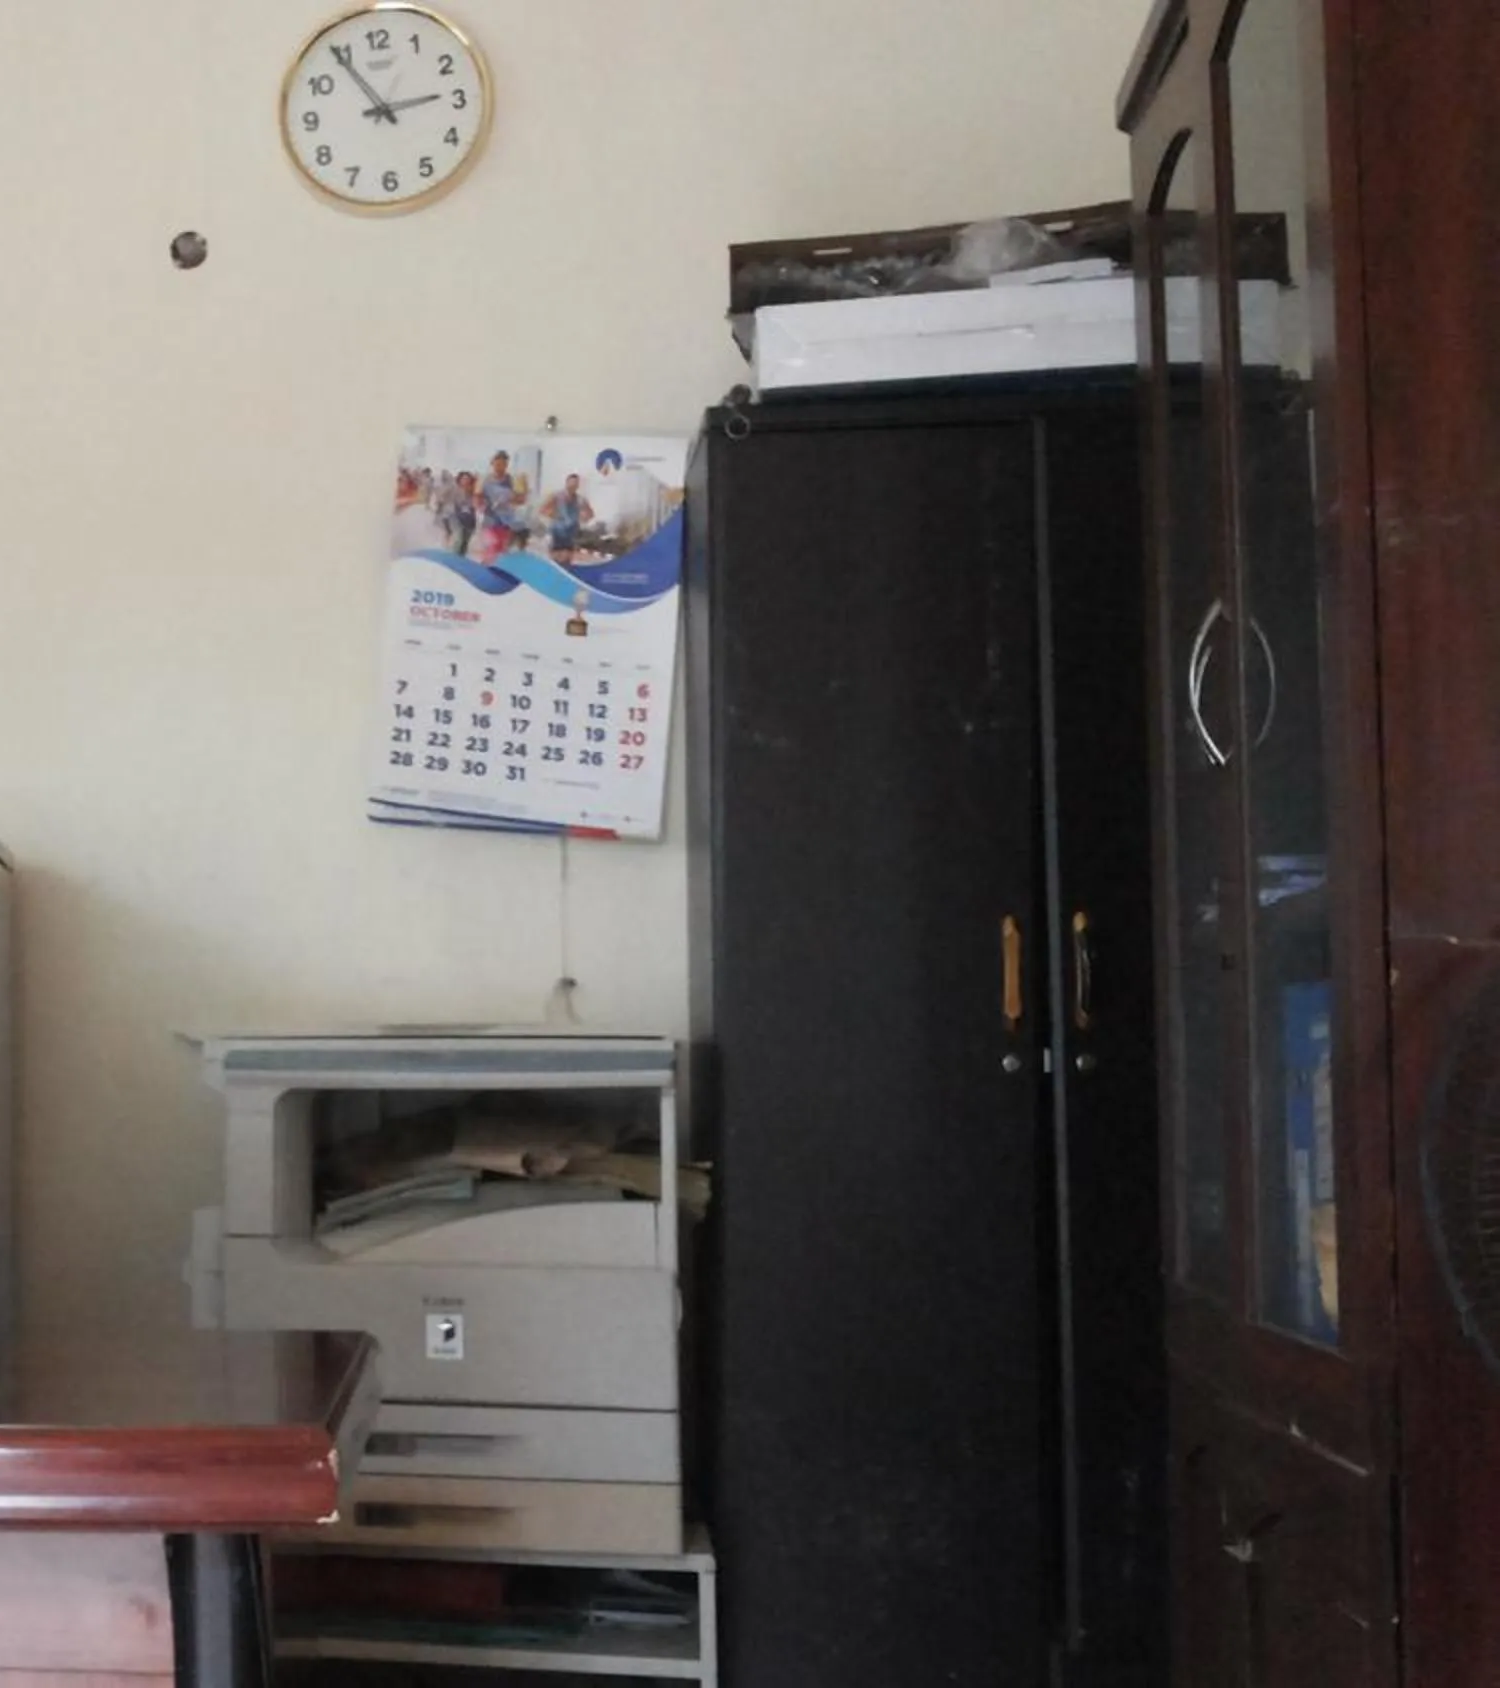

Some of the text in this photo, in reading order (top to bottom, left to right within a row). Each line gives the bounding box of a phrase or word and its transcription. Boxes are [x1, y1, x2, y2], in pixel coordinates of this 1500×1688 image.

[365, 29, 390, 50] 12
[409, 34, 420, 54] 1
[438, 54, 454, 75] 2
[308, 74, 334, 96] 10
[451, 89, 467, 110] 3
[302, 111, 319, 131] 9
[443, 127, 459, 146] 4
[315, 145, 332, 165] 8
[344, 166, 361, 187] 7
[418, 156, 434, 177] 5
[381, 171, 398, 192] 6
[411, 590, 455, 606] 2019
[410, 605, 481, 622] OCTOBER
[449, 662, 649, 699] 1 2 3 4 5 6
[396, 679, 648, 722] 7 8 9 10 11 12 13
[394, 703, 646, 746] 14 15 16 17 18 19 20
[391, 726, 644, 770] 21 22 23 24 25 26 27
[389, 750, 526, 782] 28 29 30 31
